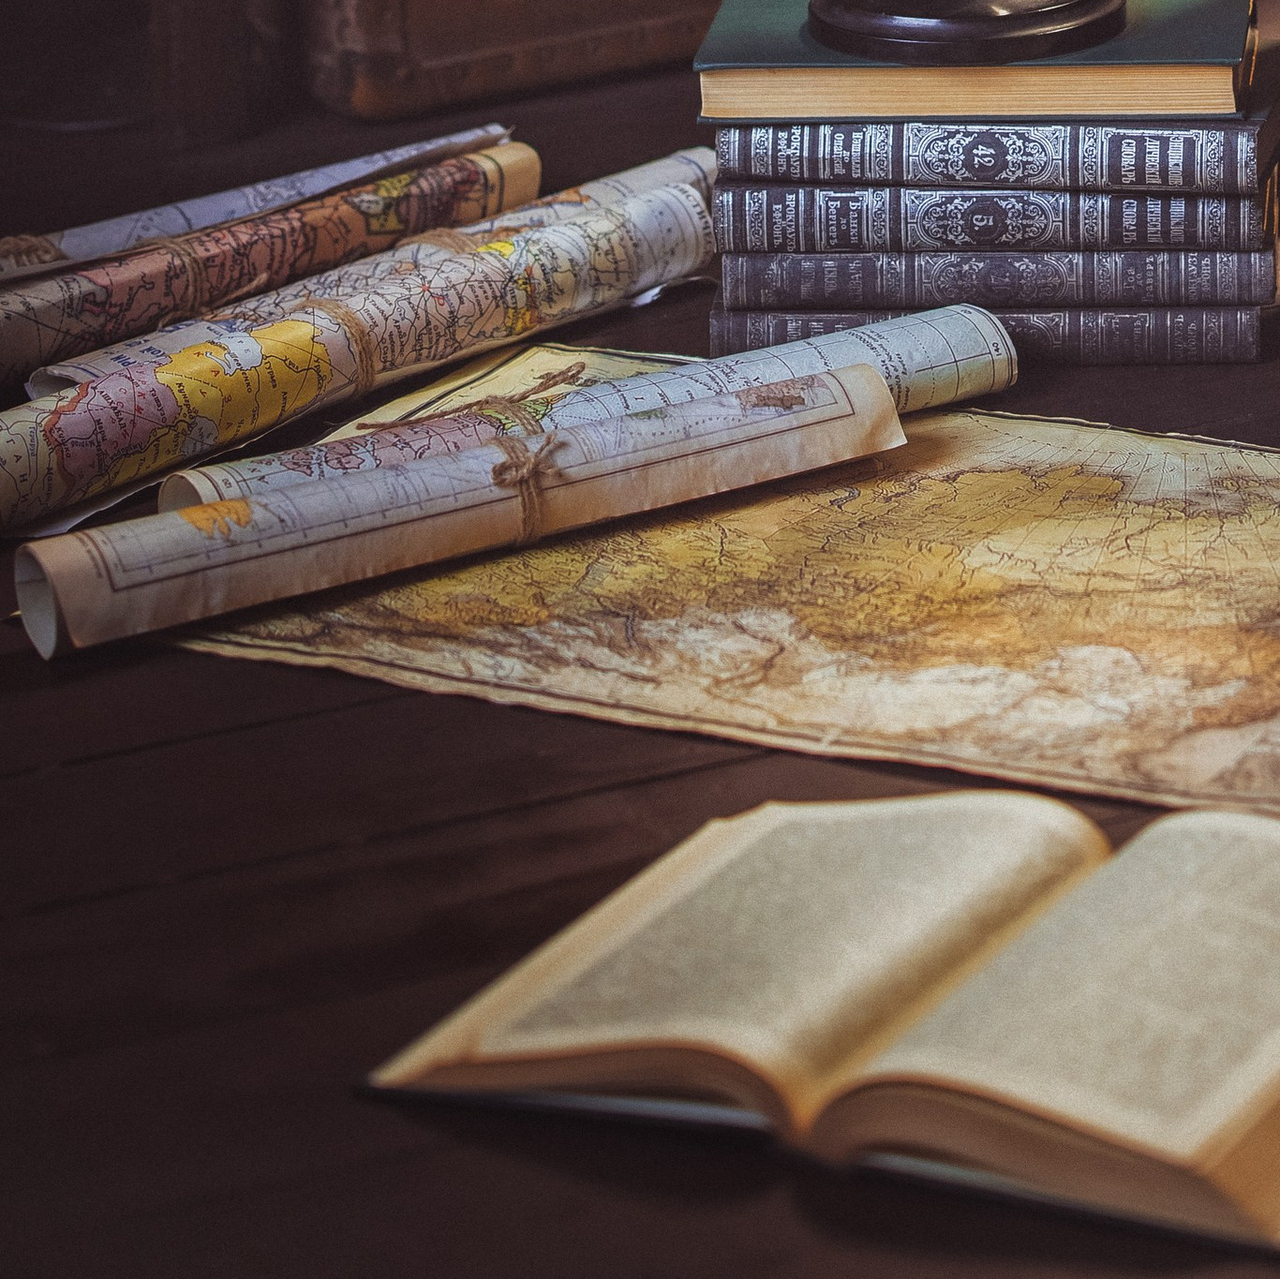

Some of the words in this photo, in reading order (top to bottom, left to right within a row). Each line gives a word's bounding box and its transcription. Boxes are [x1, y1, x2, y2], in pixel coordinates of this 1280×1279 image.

[842, 150, 850, 163] до
[1120, 138, 1136, 185] СЛОВАРЬ
[828, 200, 841, 246] Бергеръ
[840, 217, 847, 230] до
[848, 200, 861, 244] Банки
[1122, 198, 1137, 244] СЛОВАРЬ
[99, 390, 128, 430] АШХАБАД
